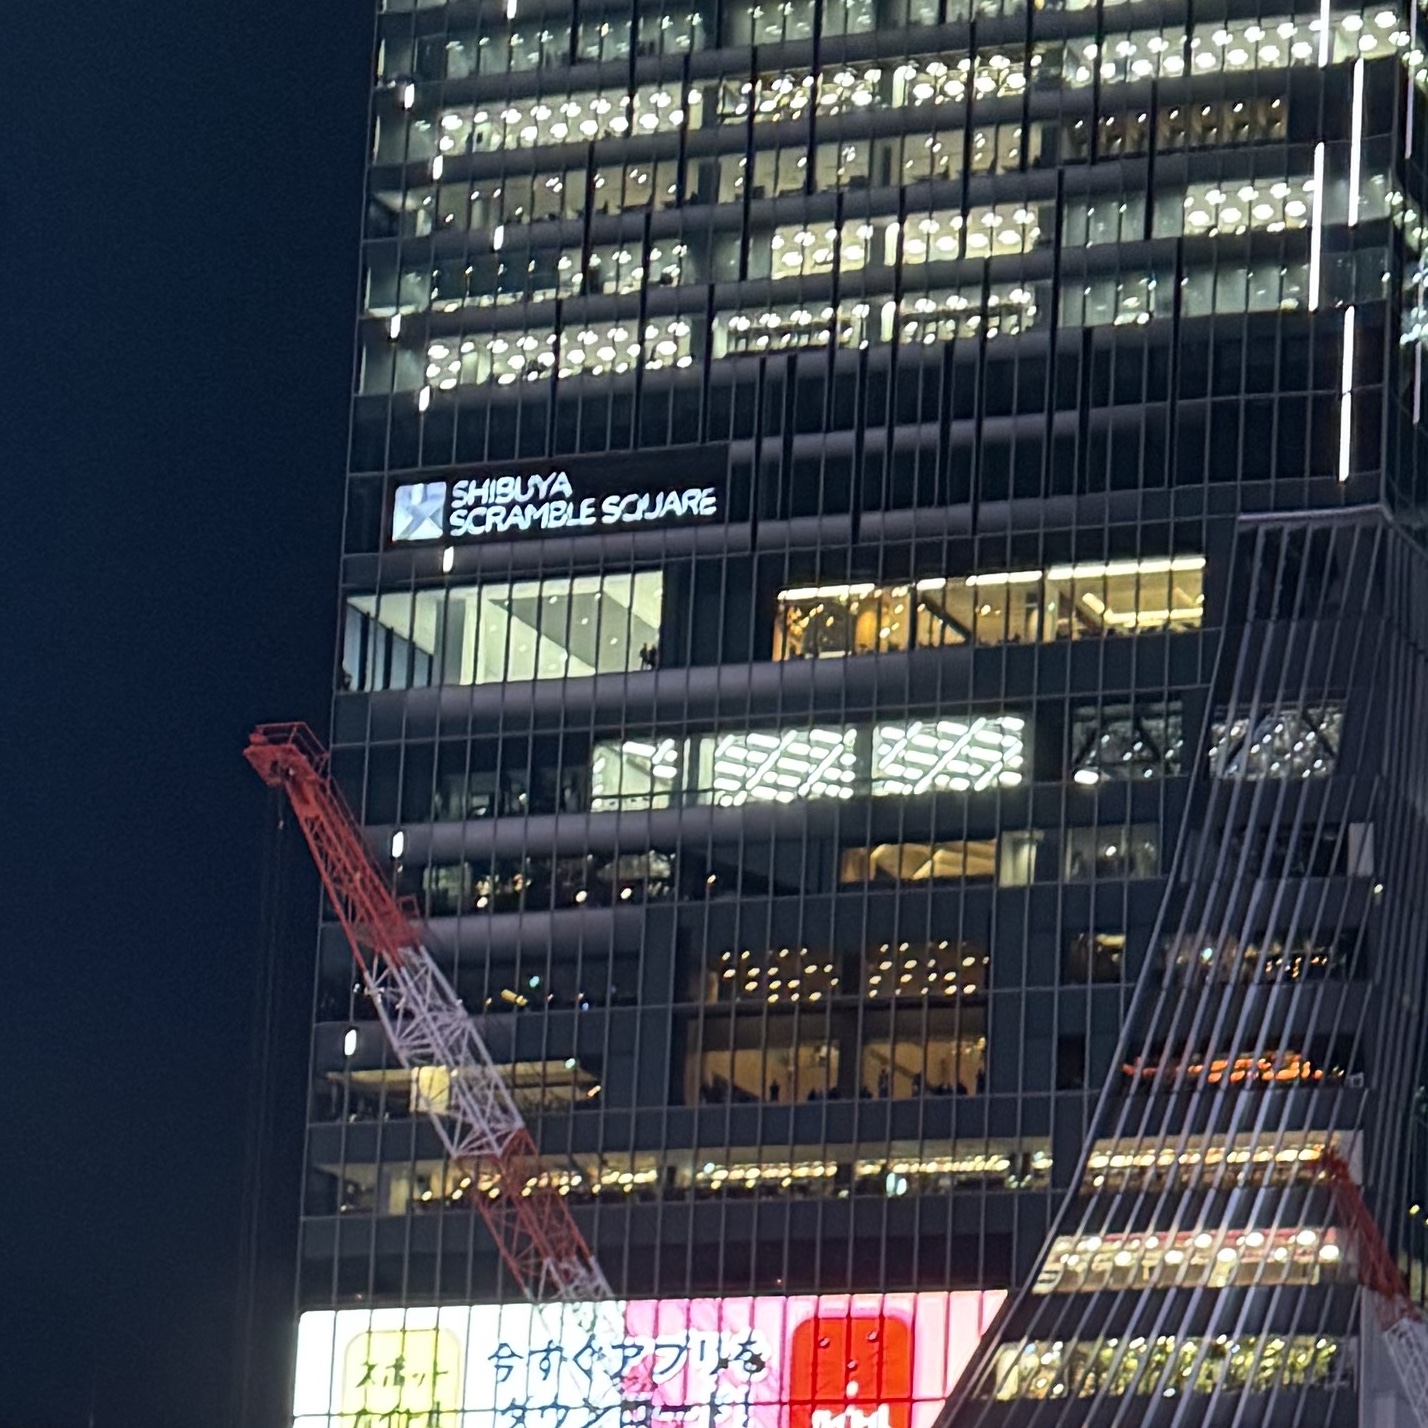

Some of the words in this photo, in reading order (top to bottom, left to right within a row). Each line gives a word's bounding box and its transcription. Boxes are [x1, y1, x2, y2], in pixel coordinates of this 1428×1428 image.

[449, 497, 597, 536] SCRAMBLE
[600, 487, 717, 524] SQUARE
[451, 471, 573, 508] SHIBUYA
[488, 1333, 767, 1381] 今すぐアプリを
